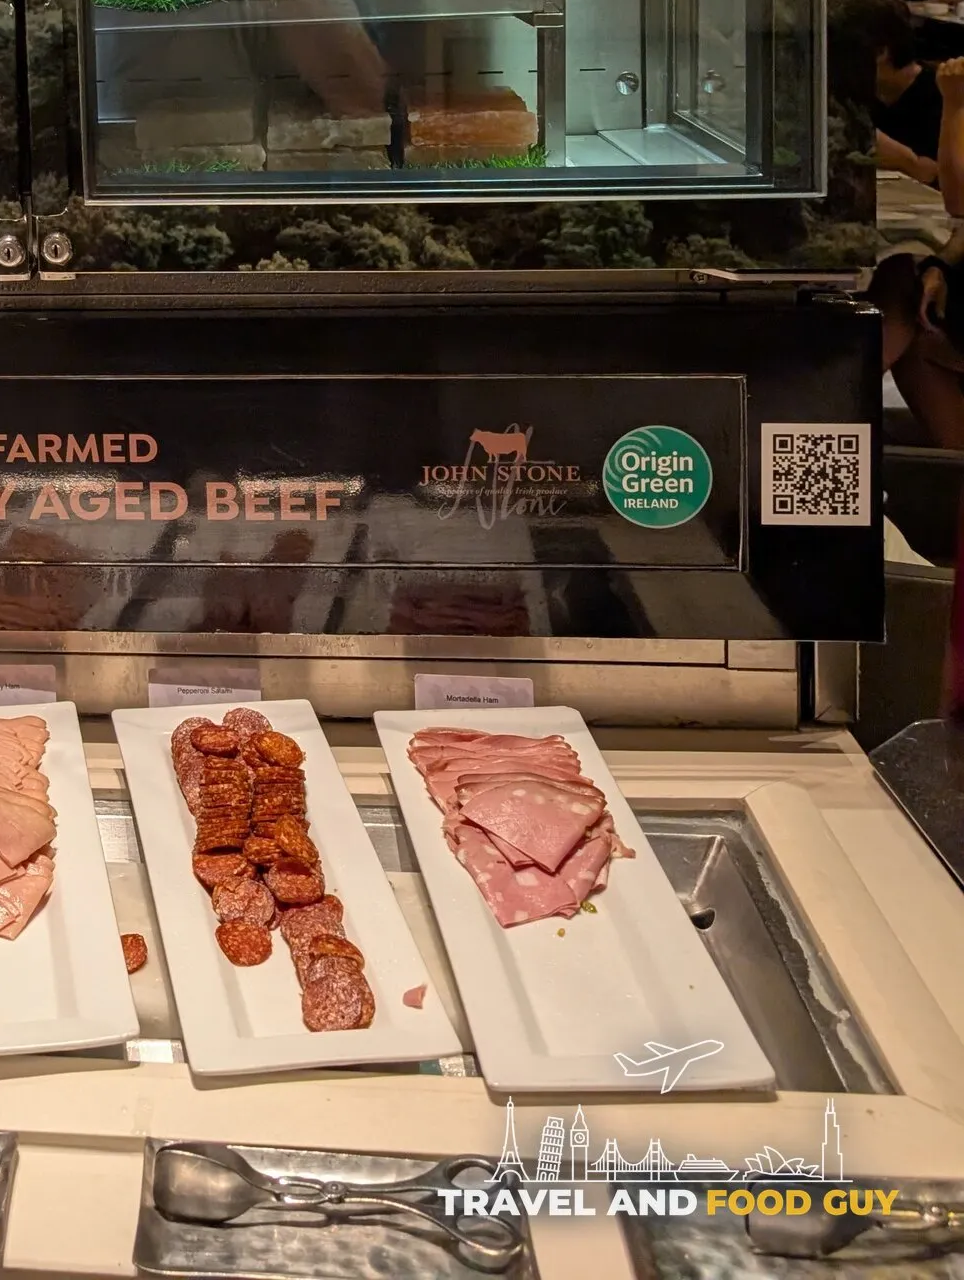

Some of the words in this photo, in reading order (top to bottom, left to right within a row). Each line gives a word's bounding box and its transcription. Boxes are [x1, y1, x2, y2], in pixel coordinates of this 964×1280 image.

[621, 451, 693, 477] Origin
[418, 465, 488, 487] JOHN
[497, 465, 581, 482] STONE
[621, 473, 693, 493] Green
[28, 481, 188, 521] AGED
[206, 481, 345, 521] BEEF
[623, 499, 679, 509] IRELAND
[446, 695, 481, 703] Mortadella
